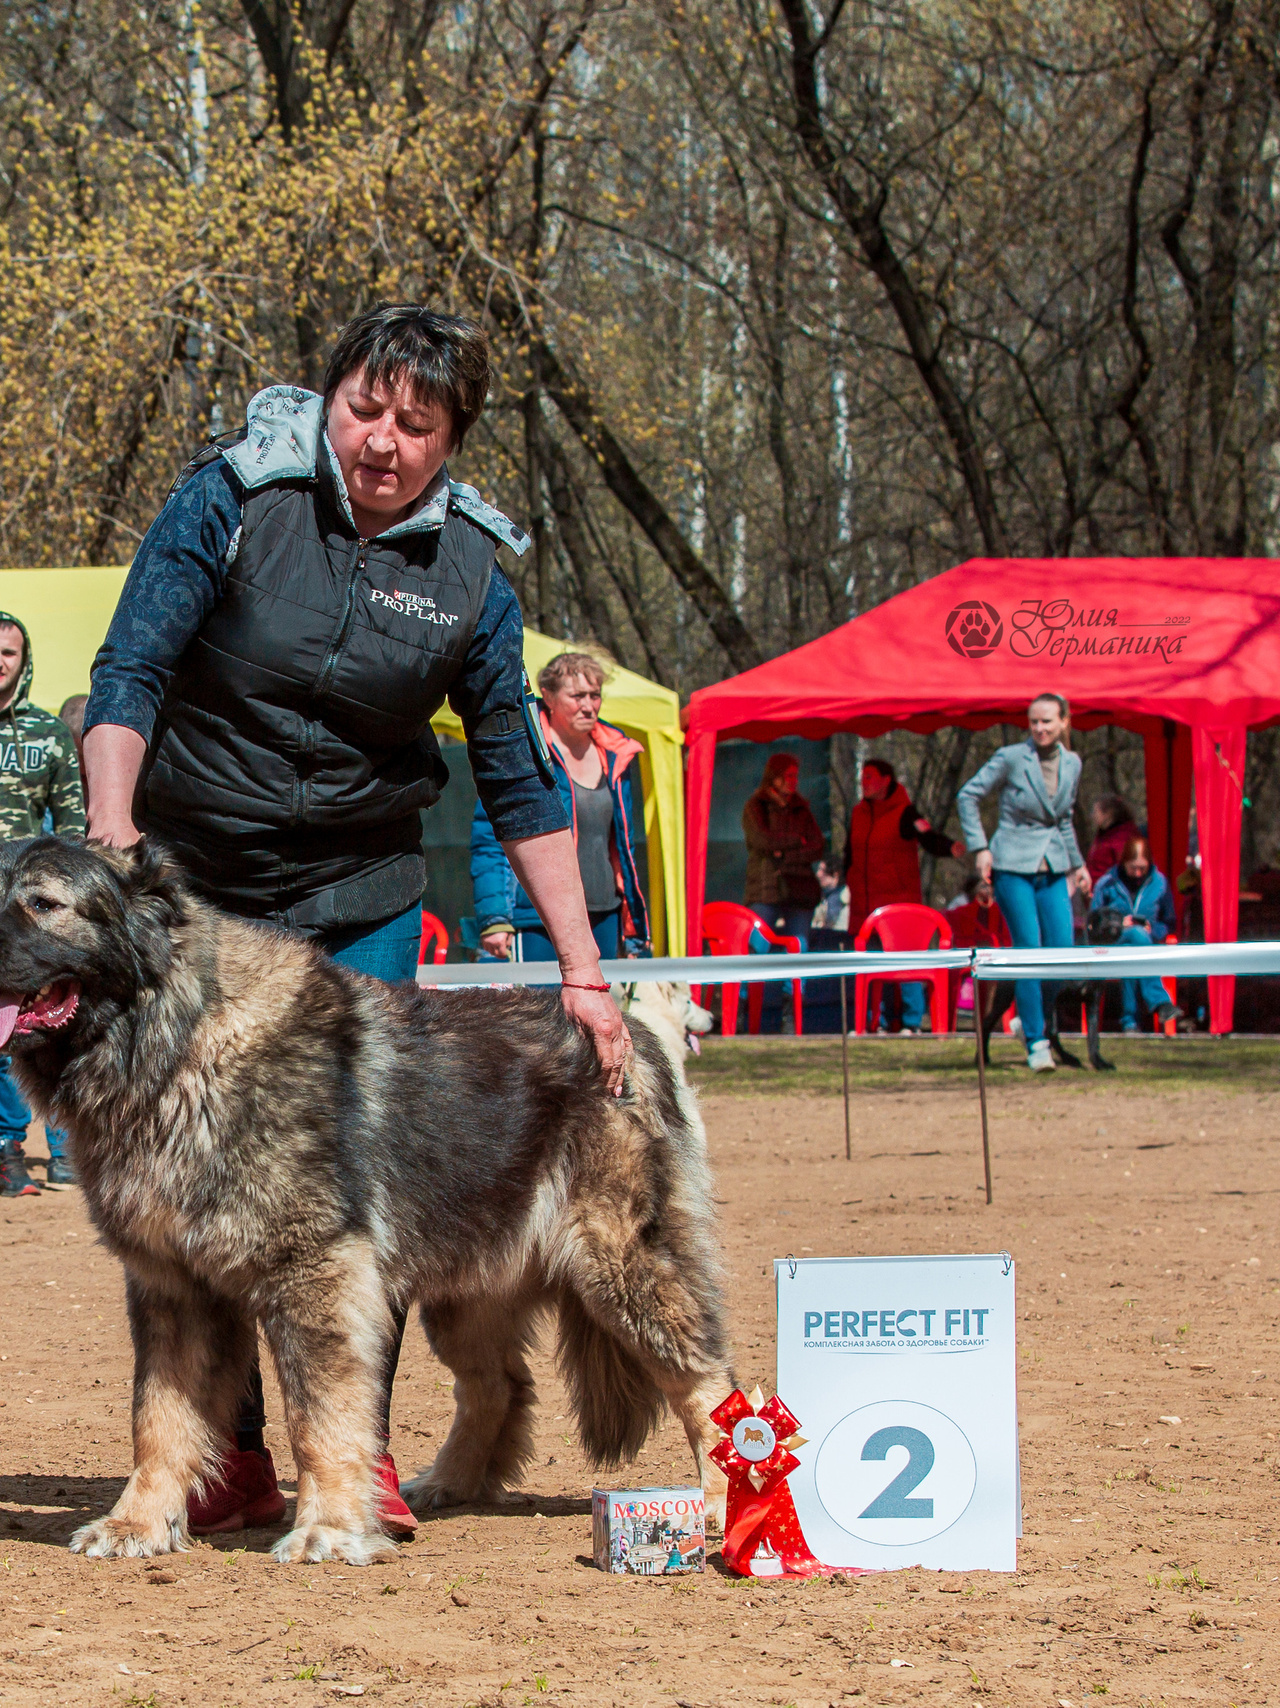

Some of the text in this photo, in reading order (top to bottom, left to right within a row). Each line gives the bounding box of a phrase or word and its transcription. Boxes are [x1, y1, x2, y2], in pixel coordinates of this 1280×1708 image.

[400, 593, 433, 607] PURINA
[804, 1308, 989, 1337] PERFECT FIT
[803, 1340, 865, 1348] КОМПЛЕКСНАЯ
[906, 1339, 948, 1348] ЗДОРОВЬЕ
[857, 1426, 935, 1518] 2
